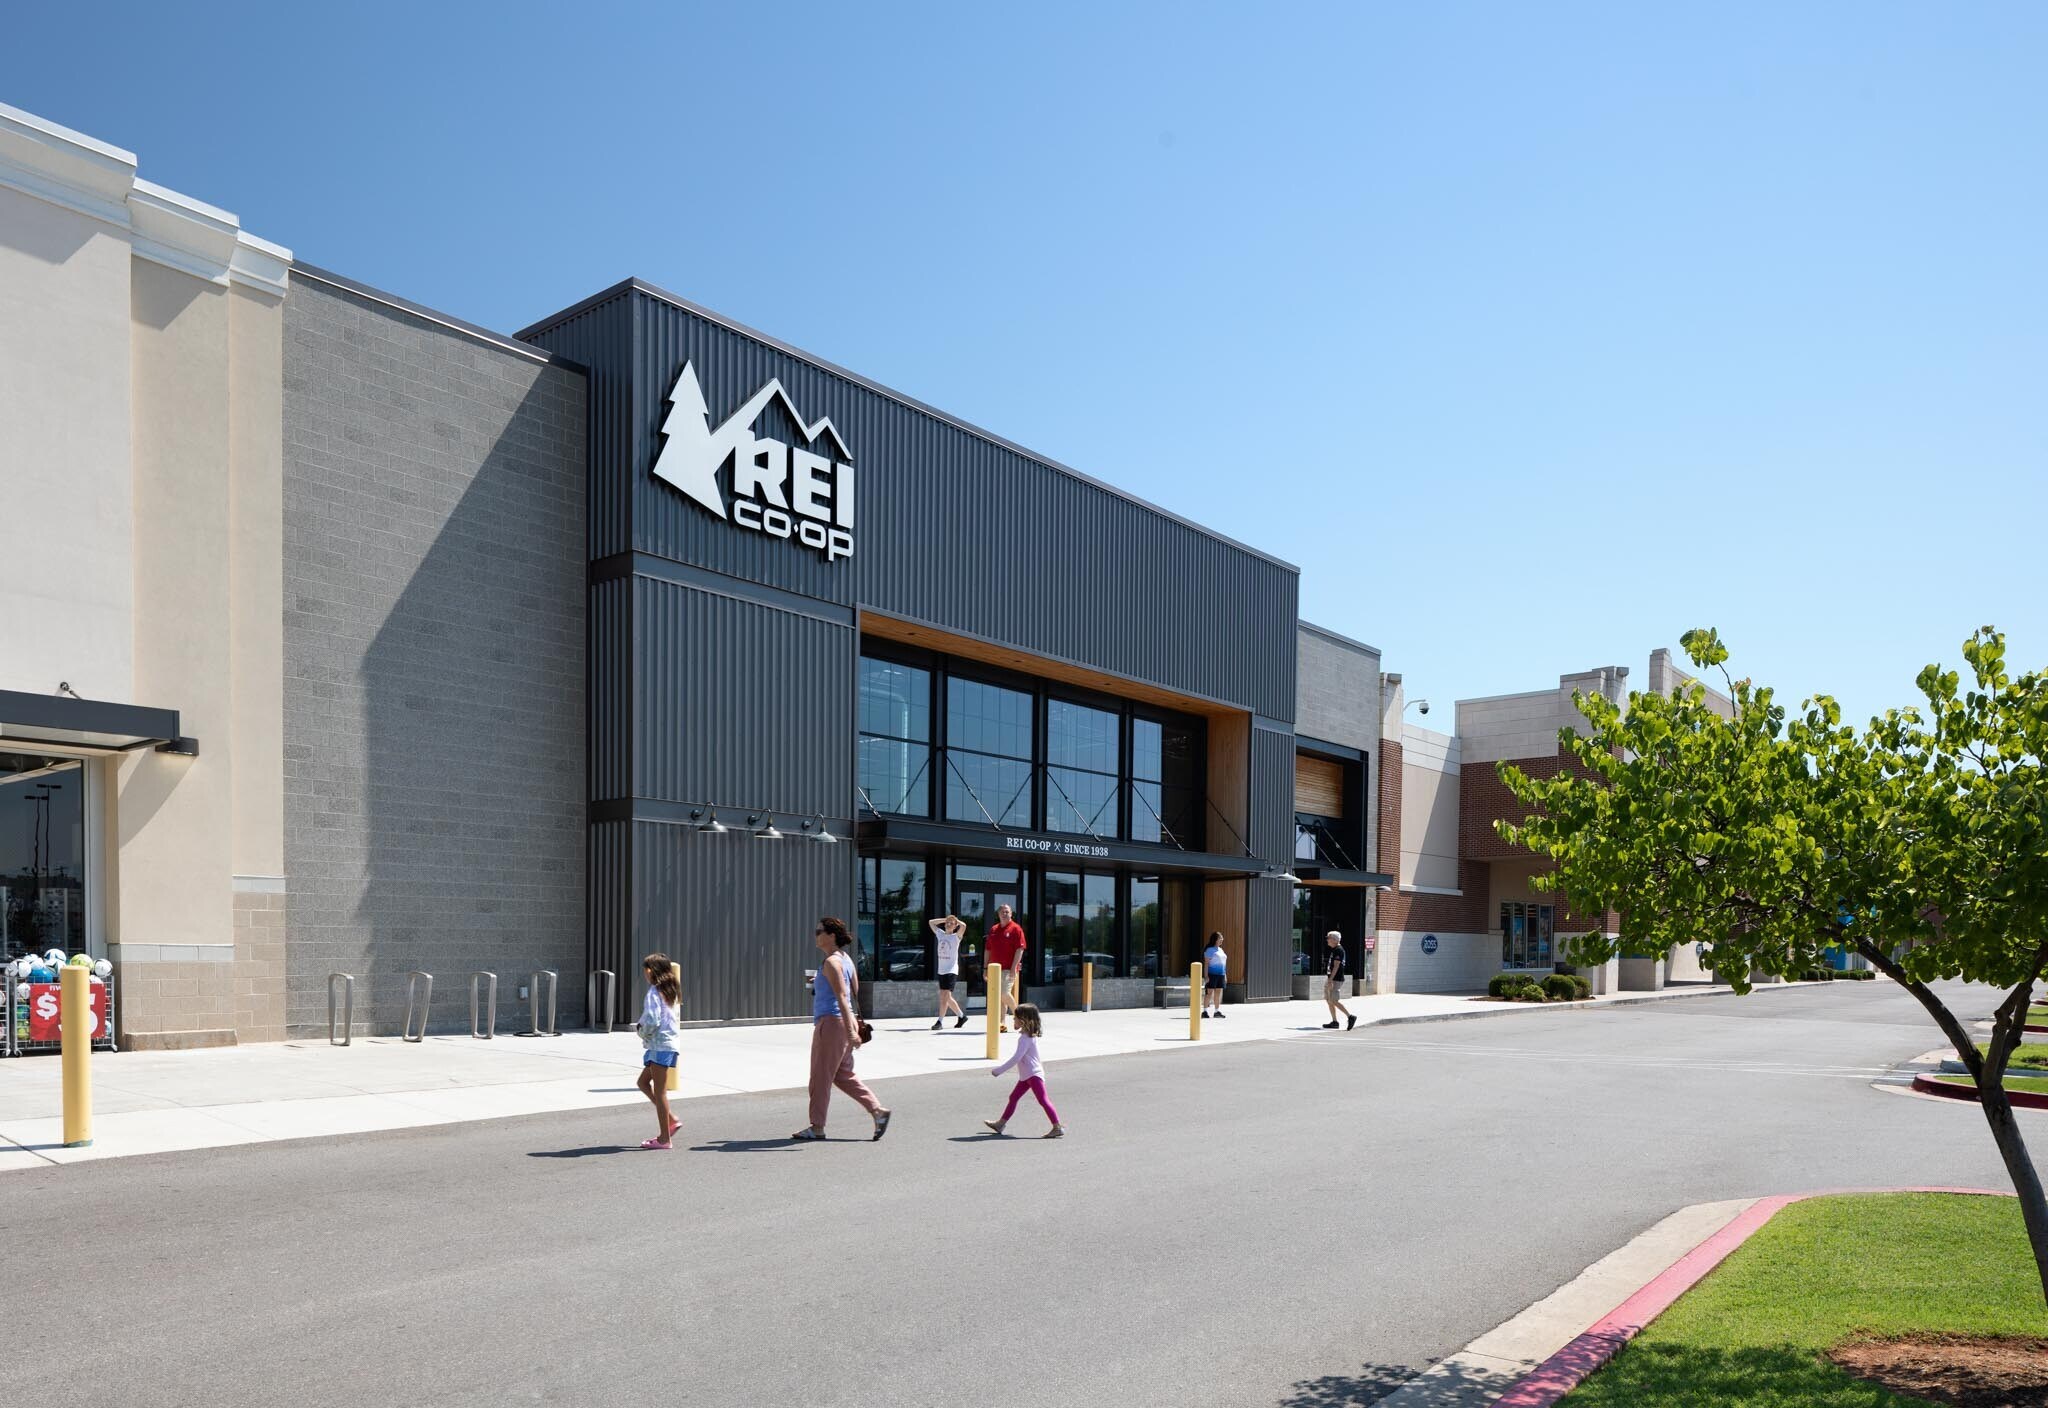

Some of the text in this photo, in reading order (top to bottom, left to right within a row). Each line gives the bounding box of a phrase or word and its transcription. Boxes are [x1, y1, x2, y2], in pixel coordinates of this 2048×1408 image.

[734, 430, 854, 529] REI
[1006, 837, 1109, 857] REI CO-OP SINCE 1938
